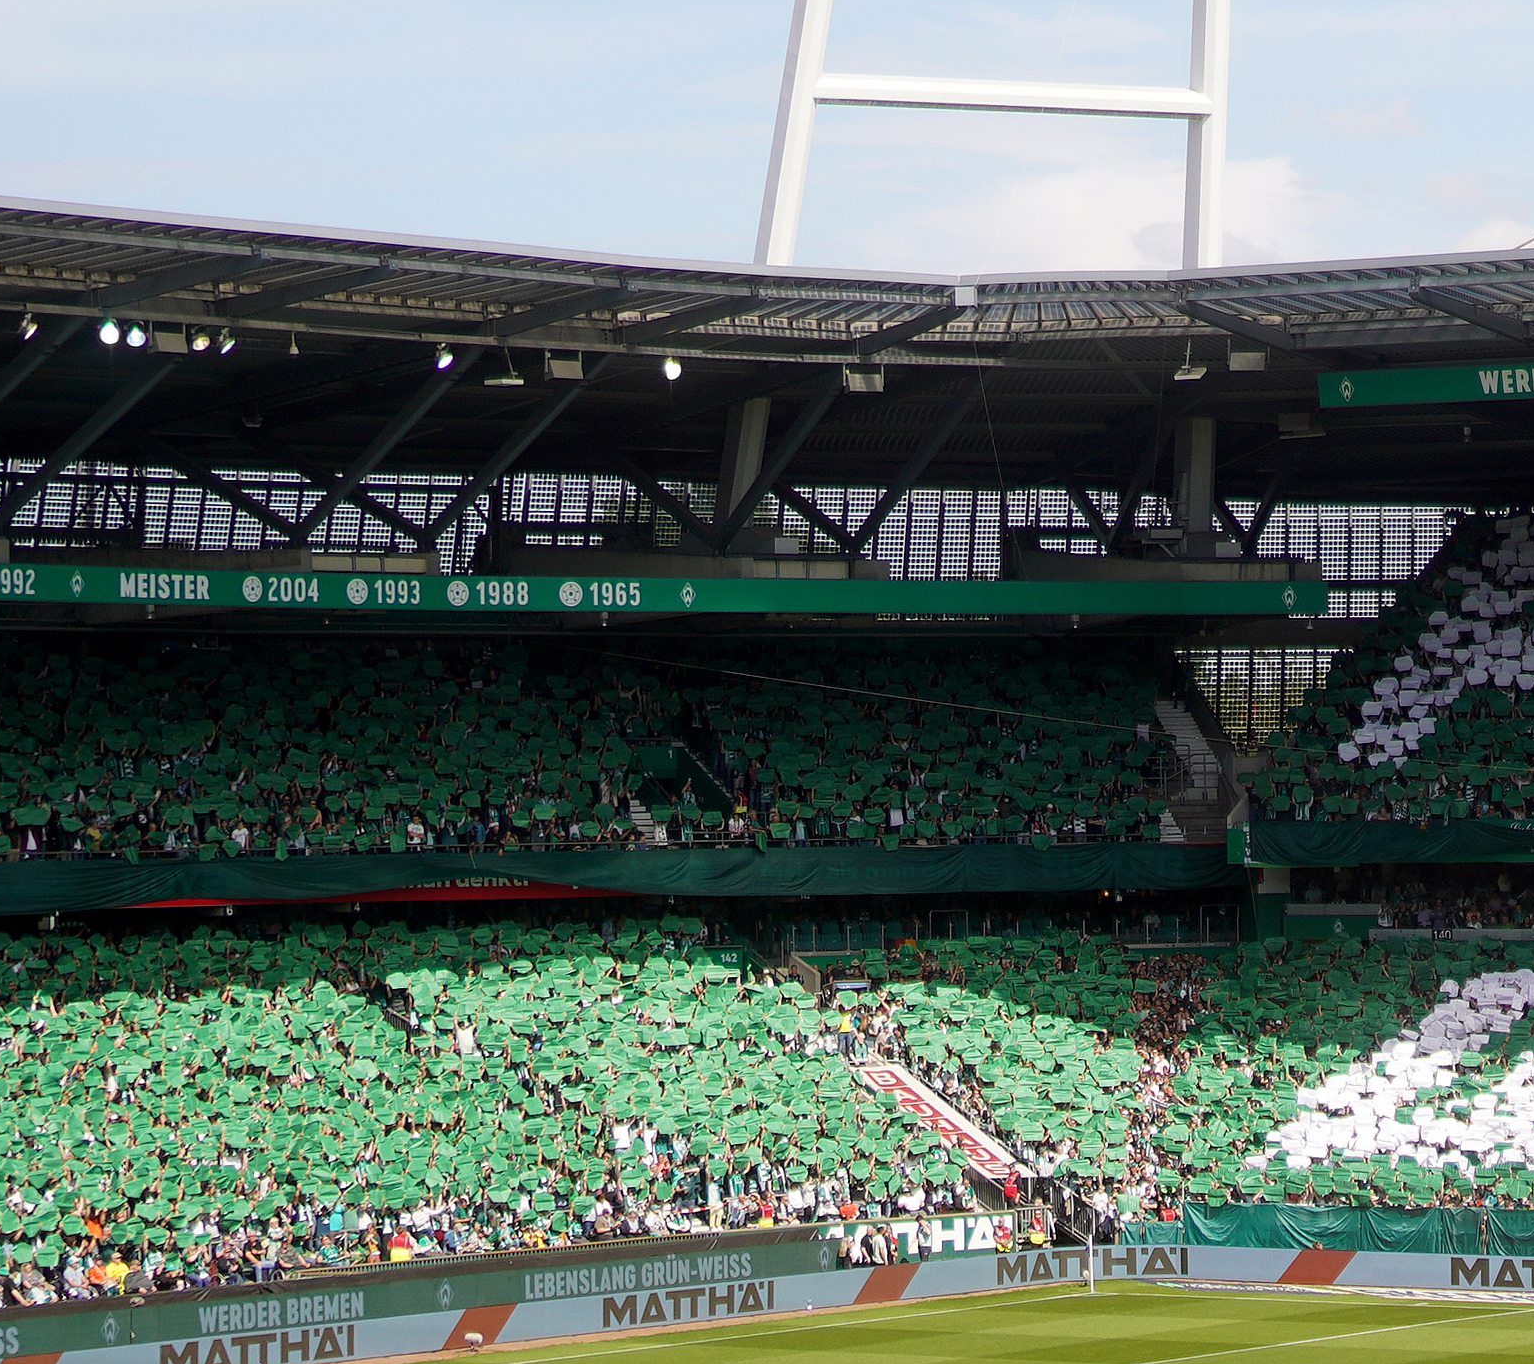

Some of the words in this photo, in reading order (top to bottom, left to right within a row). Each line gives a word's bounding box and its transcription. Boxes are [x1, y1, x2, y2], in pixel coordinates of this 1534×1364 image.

[118, 571, 211, 602] MEISTER
[267, 575, 320, 604] 2004
[373, 577, 422, 606] 1993
[475, 580, 531, 607] 1988
[589, 580, 643, 608] 1965
[1432, 929, 1452, 940] 140
[720, 952, 739, 964] 142
[524, 1266, 636, 1300] LEBENSLANG
[641, 1252, 752, 1288] GRÜN-WEISS
[998, 1245, 1190, 1286] MATTHÄI
[198, 1299, 282, 1334] WERDER
[286, 1290, 365, 1327] BREMEN
[602, 1280, 774, 1328] MATTHÄI
